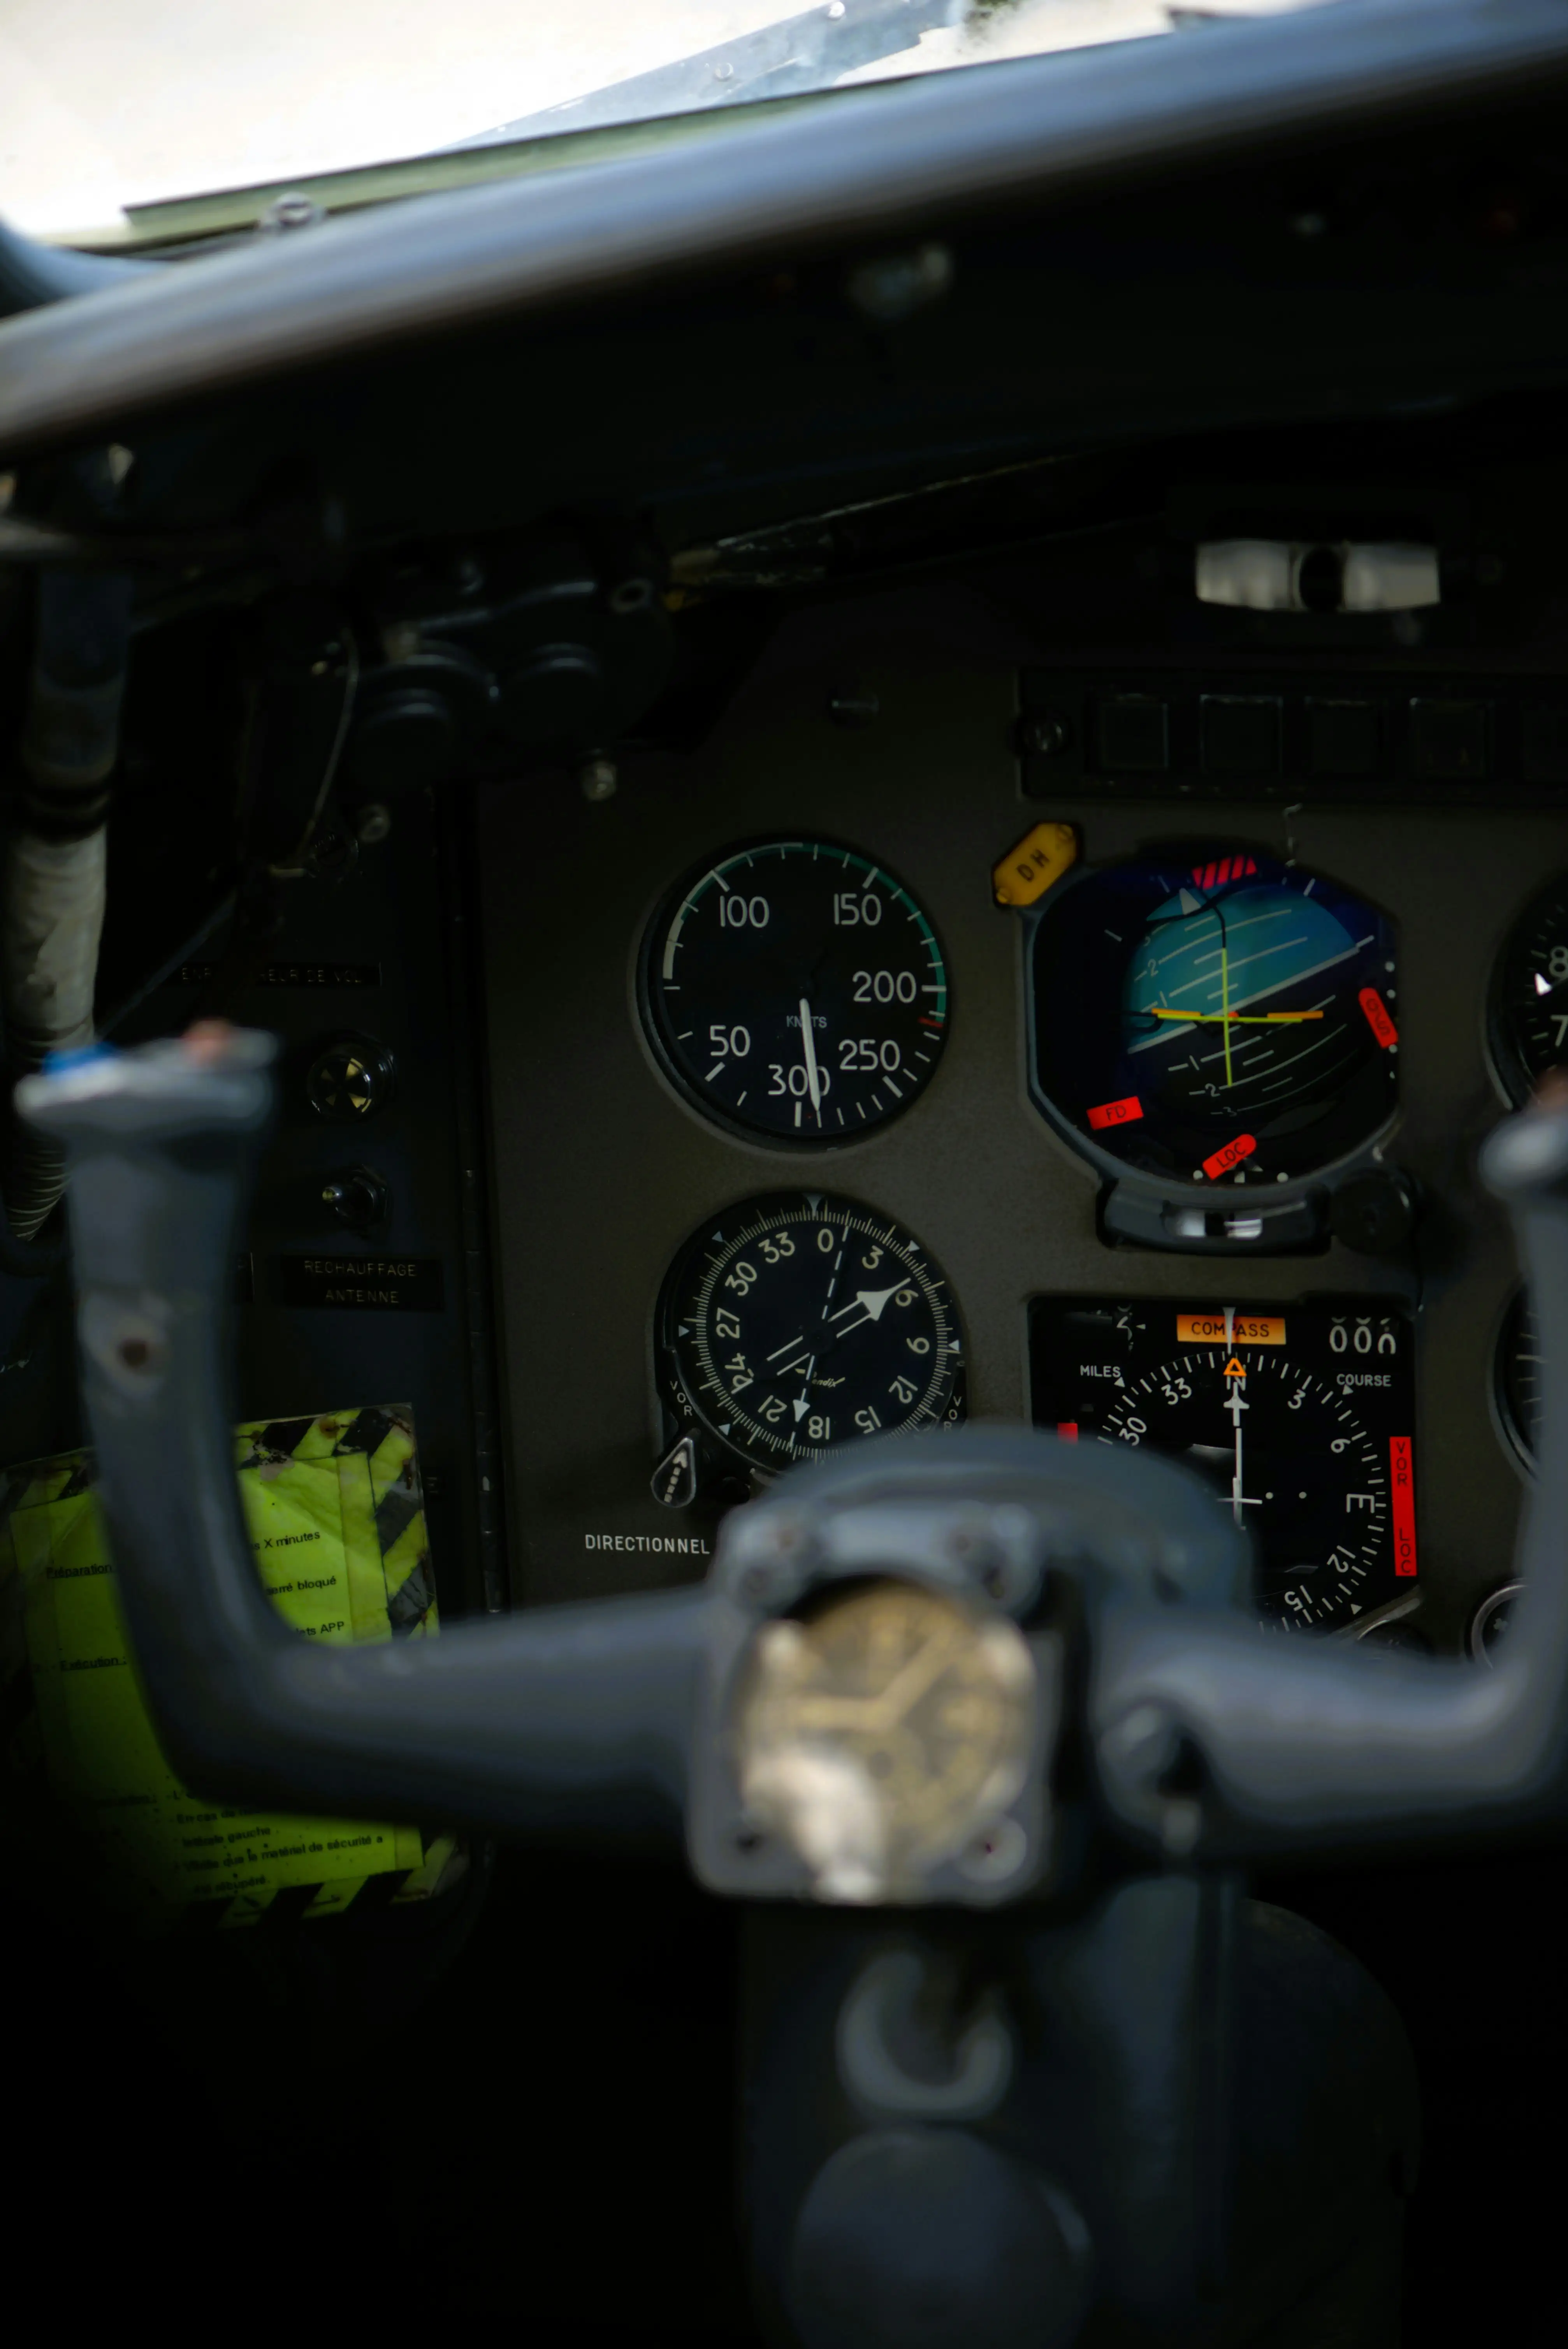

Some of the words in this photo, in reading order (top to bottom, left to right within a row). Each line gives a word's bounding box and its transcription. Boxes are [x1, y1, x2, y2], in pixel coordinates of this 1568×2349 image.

[720, 895, 770, 928] 100
[834, 893, 882, 925] 150
[853, 971, 917, 1003] 200
[786, 1016, 827, 1029] KNTS
[1549, 1014, 1568, 1048] 7
[710, 1025, 751, 1057] 50
[838, 1039, 901, 1071] 250
[768, 1064, 831, 1096] 300
[1105, 1104, 1127, 1122] FD
[1216, 1142, 1246, 1169] LOC
[758, 1231, 796, 1264] 33
[817, 1228, 834, 1253] 0
[304, 1260, 417, 1277] RECHAUFFAGE
[861, 1245, 884, 1270] 3
[725, 1262, 758, 1297] 30
[325, 1289, 399, 1304] ANTENNE
[895, 1289, 919, 1308] 6
[715, 1307, 741, 1339] 27
[1191, 1321, 1270, 1338] COMASS
[906, 1337, 930, 1354] 9
[724, 1352, 754, 1395] 24
[1079, 1364, 1122, 1378] MILES
[1336, 1373, 1392, 1387] COURSE
[888, 1375, 919, 1404] 12
[1161, 1377, 1193, 1406] 33
[1287, 1389, 1306, 1410] 3
[757, 1394, 788, 1422] 21
[854, 1405, 882, 1435] 15
[807, 1415, 830, 1440] 18
[1118, 1416, 1148, 1446] 30
[1330, 1436, 1351, 1454] 6
[1396, 1441, 1407, 1487] VOR
[1345, 1493, 1375, 1514] E
[264, 1538, 273, 1549] X
[276, 1531, 320, 1547] minutes
[585, 1534, 710, 1555] DIRECTIONNEL
[1399, 1526, 1411, 1573] LOC
[46, 1563, 112, 1579] Préparation
[1326, 1544, 1356, 1574] 12
[297, 1575, 337, 1591] bloqué
[1283, 1584, 1313, 1612] 15
[320, 1621, 345, 1634] APP
[227, 1826, 271, 1843] gauche
[262, 1844, 306, 1860] matériel
[309, 1842, 323, 1853] de
[327, 1836, 372, 1851] sécurité
